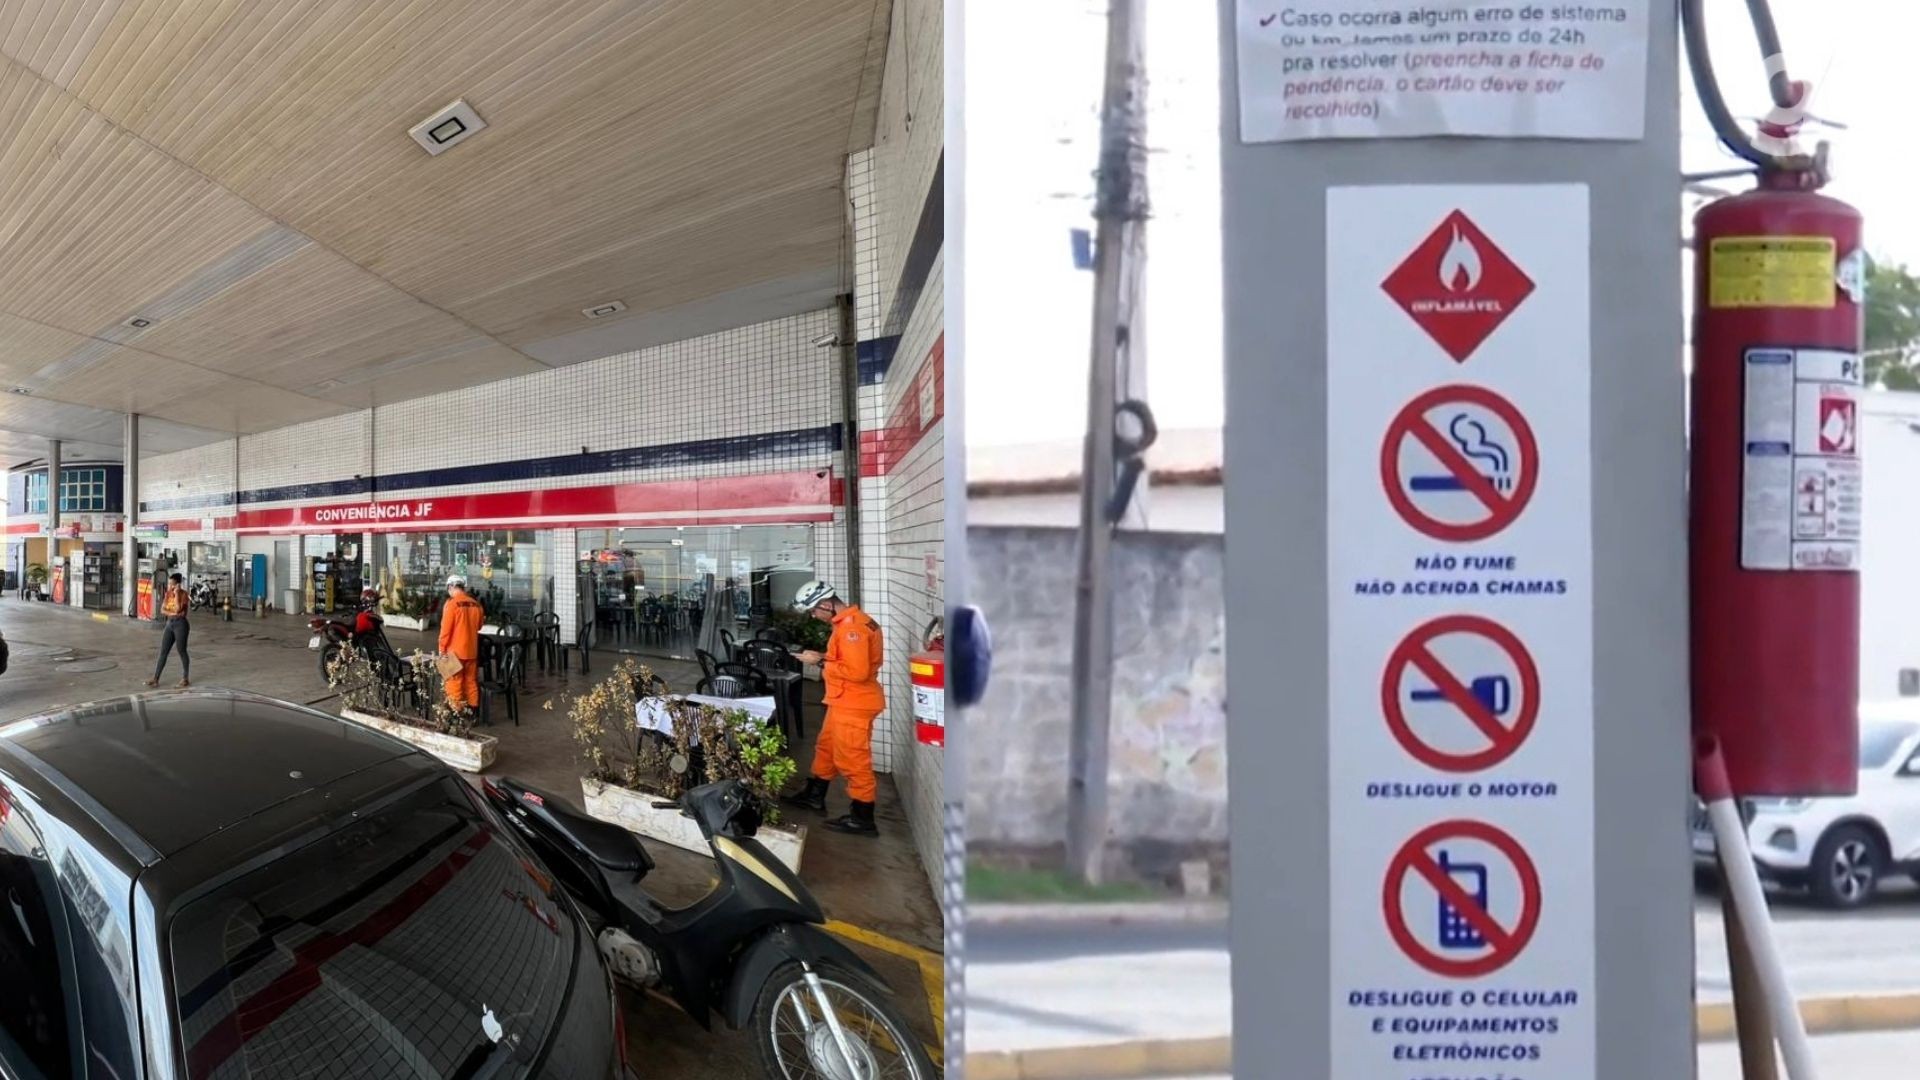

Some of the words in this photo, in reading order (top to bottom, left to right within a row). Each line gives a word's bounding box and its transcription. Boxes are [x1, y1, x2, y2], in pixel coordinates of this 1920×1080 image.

[1280, 8, 1334, 28] Caso
[1338, 11, 1402, 27] ocorra
[1406, 7, 1469, 27] algum
[1473, 8, 1514, 22] erro
[1519, 6, 1545, 21] de
[1551, 4, 1628, 23] sistema
[1456, 29, 1513, 46] prazo
[1518, 28, 1544, 44] de
[1548, 27, 1585, 44] 24h
[1282, 57, 1315, 75] pra
[1320, 52, 1397, 70] resolver
[1403, 52, 1505, 72] (preencha
[1509, 54, 1522, 68] a
[1527, 50, 1575, 70] ficha
[1579, 53, 1605, 72] de
[1395, 81, 1408, 94] o
[1413, 75, 1475, 94] cartão
[1480, 77, 1529, 93] deve
[1534, 79, 1566, 94] ser
[1284, 100, 1380, 120] recolhido)
[1411, 299, 1502, 312] INFLAMÁVEL
[315, 504, 410, 521] CONVENIÊNCIA
[414, 502, 433, 516] JF
[1415, 554, 1456, 571] NÃO
[1463, 555, 1517, 571] FUME
[1355, 578, 1395, 595] NÃO
[1402, 580, 1479, 594] ACENDA
[1487, 580, 1567, 595] CHAMAS
[1367, 783, 1462, 798] DESLIGUE
[1468, 783, 1483, 796] O
[1488, 783, 1558, 796] MOTOR
[1349, 990, 1454, 1007] DESLIGUE
[1460, 991, 1477, 1006] O
[1482, 991, 1579, 1006] CELULAR
[1372, 1017, 1386, 1033] E
[1391, 1017, 1560, 1034] EQUIPAMENTOS
[1393, 1042, 1541, 1061] ELETRÔNICOS
